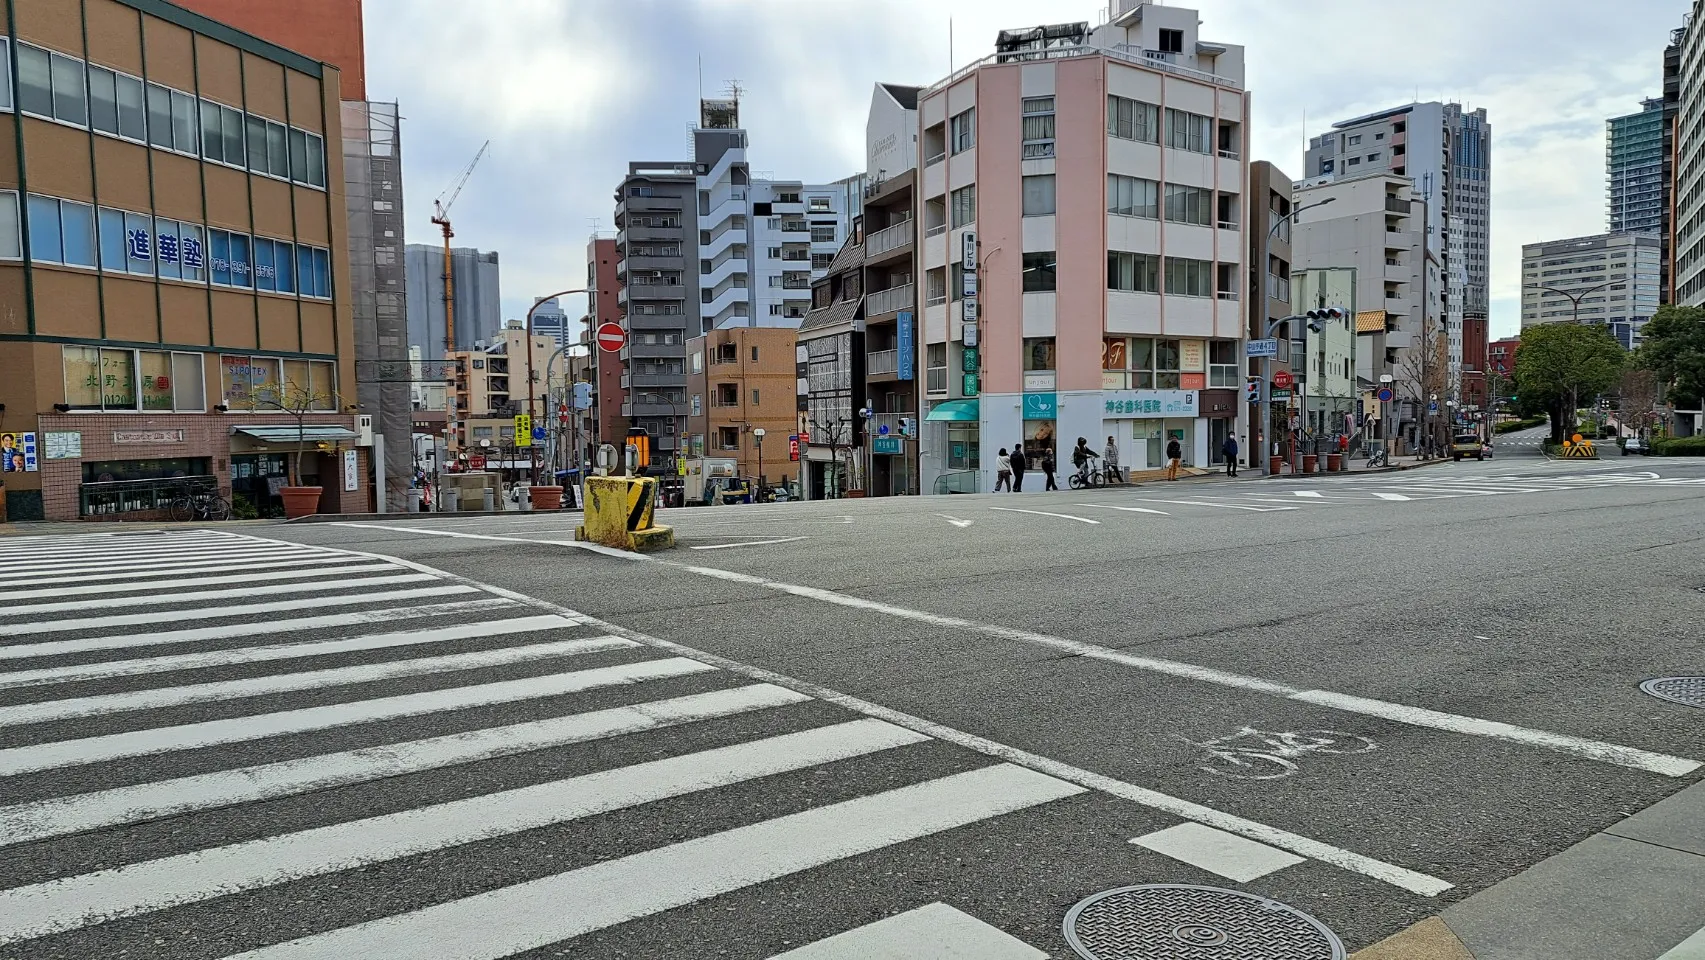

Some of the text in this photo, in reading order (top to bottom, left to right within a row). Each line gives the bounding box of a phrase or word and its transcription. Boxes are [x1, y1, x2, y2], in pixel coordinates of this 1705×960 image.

[128, 229, 203, 268] 進華塾
[1105, 400, 1161, 413] 神谷歯科医院
[25, 434, 36, 464] 自民党
